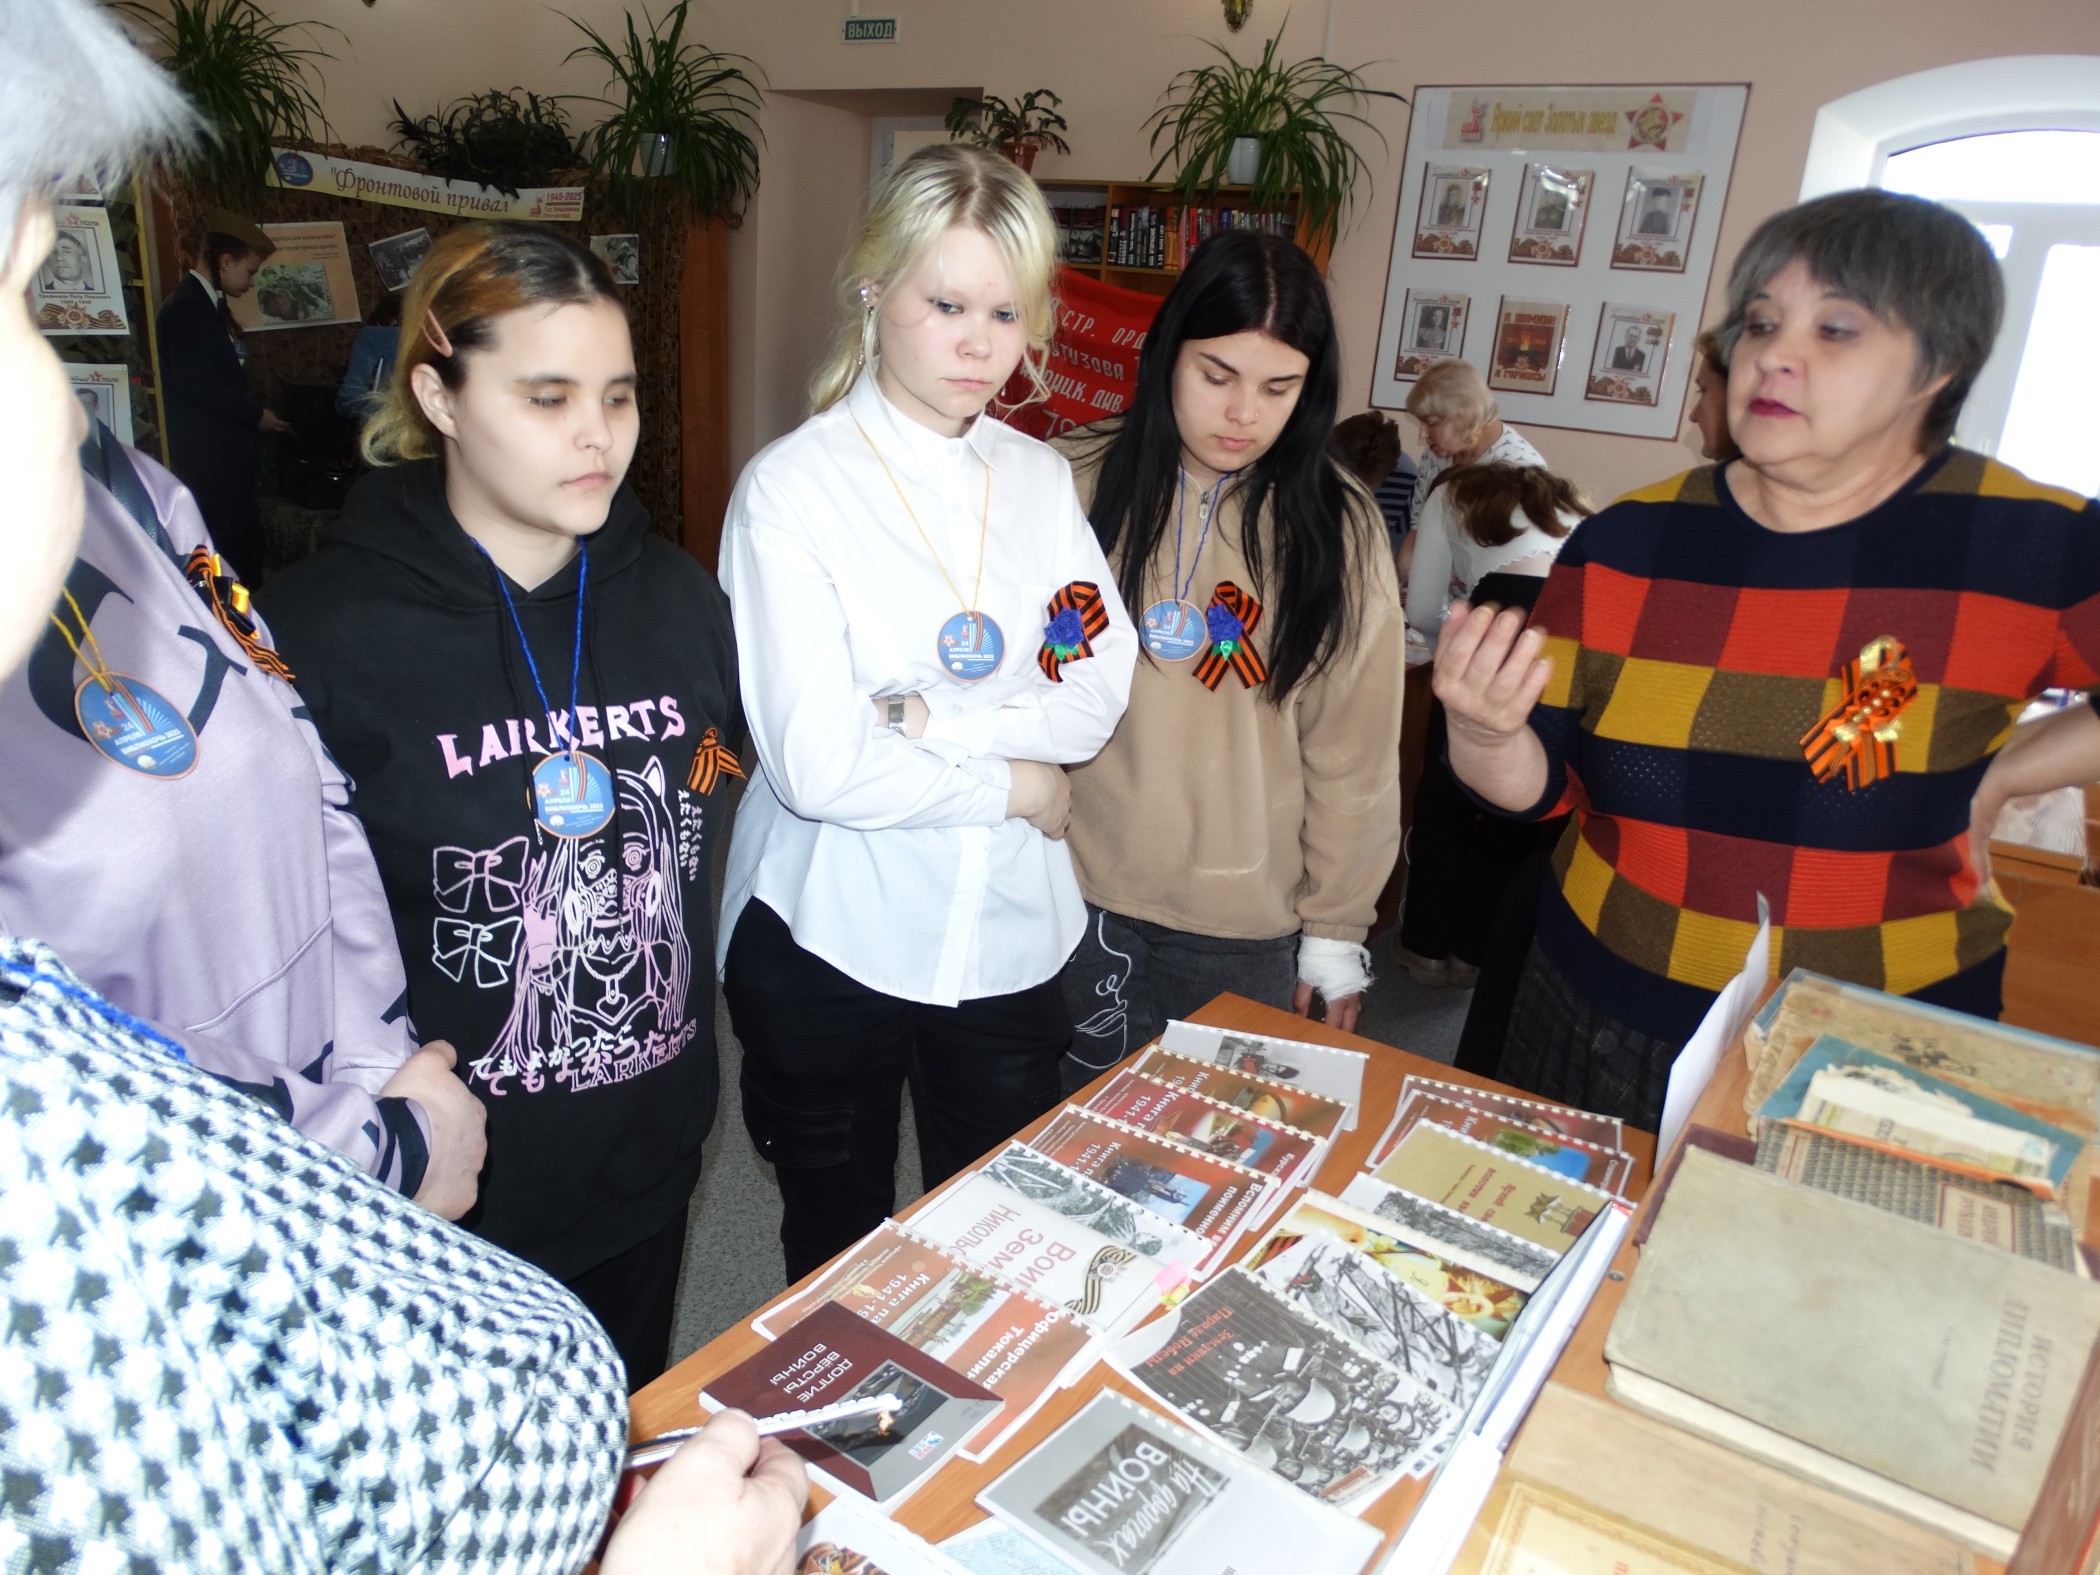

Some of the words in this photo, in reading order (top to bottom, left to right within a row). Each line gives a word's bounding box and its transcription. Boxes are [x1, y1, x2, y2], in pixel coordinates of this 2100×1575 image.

[848, 22, 893, 39] ВЫХОД
[546, 191, 583, 201] 1945-2025
[1061, 310, 1096, 338] СТР.
[1047, 338, 1124, 381] УТУЗОВА
[1089, 389, 1124, 414] ДИВ.
[121, 721, 135, 731] 24
[436, 695, 686, 779] LARKERTS
[560, 788, 570, 797] 24
[1142, 1089, 1180, 1122] Книга
[1092, 1140, 1122, 1169] Книга
[1217, 1182, 1262, 1234] Вспомним
[1493, 1182, 1516, 1207] Яркий
[889, 1272, 931, 1307] Книга
[1191, 1306, 1233, 1338] Параде
[770, 1342, 827, 1385] ВОЙНЫ
[1146, 1335, 1193, 1368] Победы
[1183, 1328, 1235, 1366] Земляки
[782, 1350, 841, 1394] ВЁРСТЫ
[796, 1358, 854, 1403] ДОЛГИЕ
[1167, 1362, 1185, 1376] на
[1969, 1299, 2030, 1474] ДИПЛОМАТИИ
[2011, 1334, 2054, 1452] ИСТОРИЯ
[1060, 1441, 1168, 1537] ВОЙНЫ
[1169, 1458, 1218, 1497] На
[1092, 1479, 1178, 1568] дорогах
